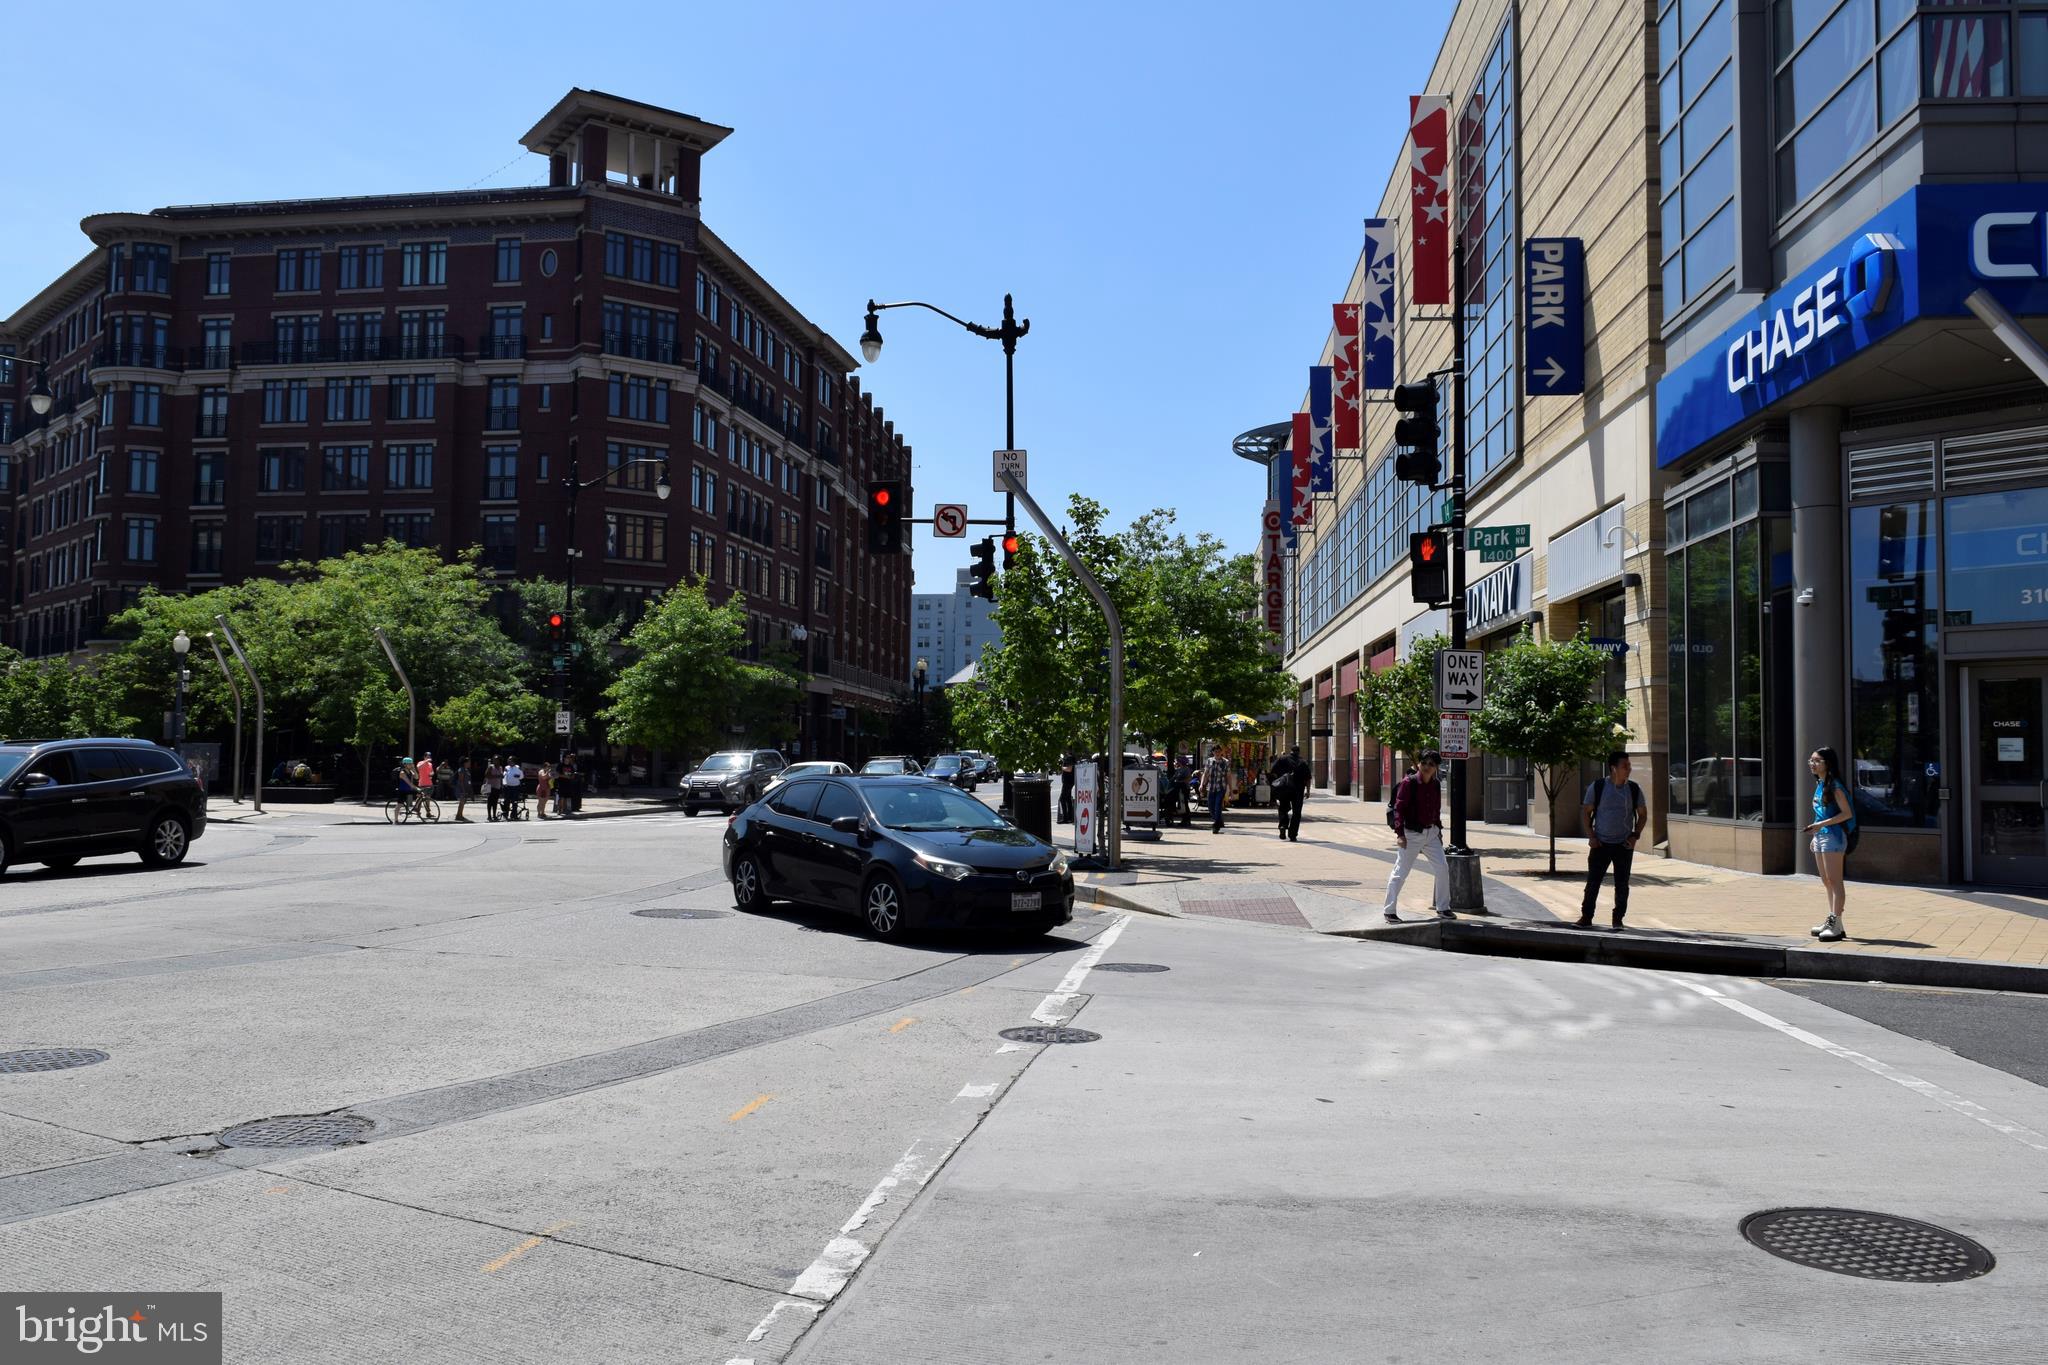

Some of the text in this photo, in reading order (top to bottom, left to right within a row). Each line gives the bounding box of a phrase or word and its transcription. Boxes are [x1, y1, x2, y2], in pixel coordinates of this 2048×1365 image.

[1973, 212, 2048, 277] C
[1531, 242, 1565, 329] PARK
[1728, 267, 1840, 393] CHASE
[1003, 453, 1017, 461] NO
[1474, 528, 1526, 547] Park RD
[1484, 549, 1513, 562] 1400
[1465, 563, 1515, 629] LD NAVY
[1447, 655, 1478, 669] ONE
[1448, 672, 1479, 686] WAY
[1078, 790, 1093, 803] PARK
